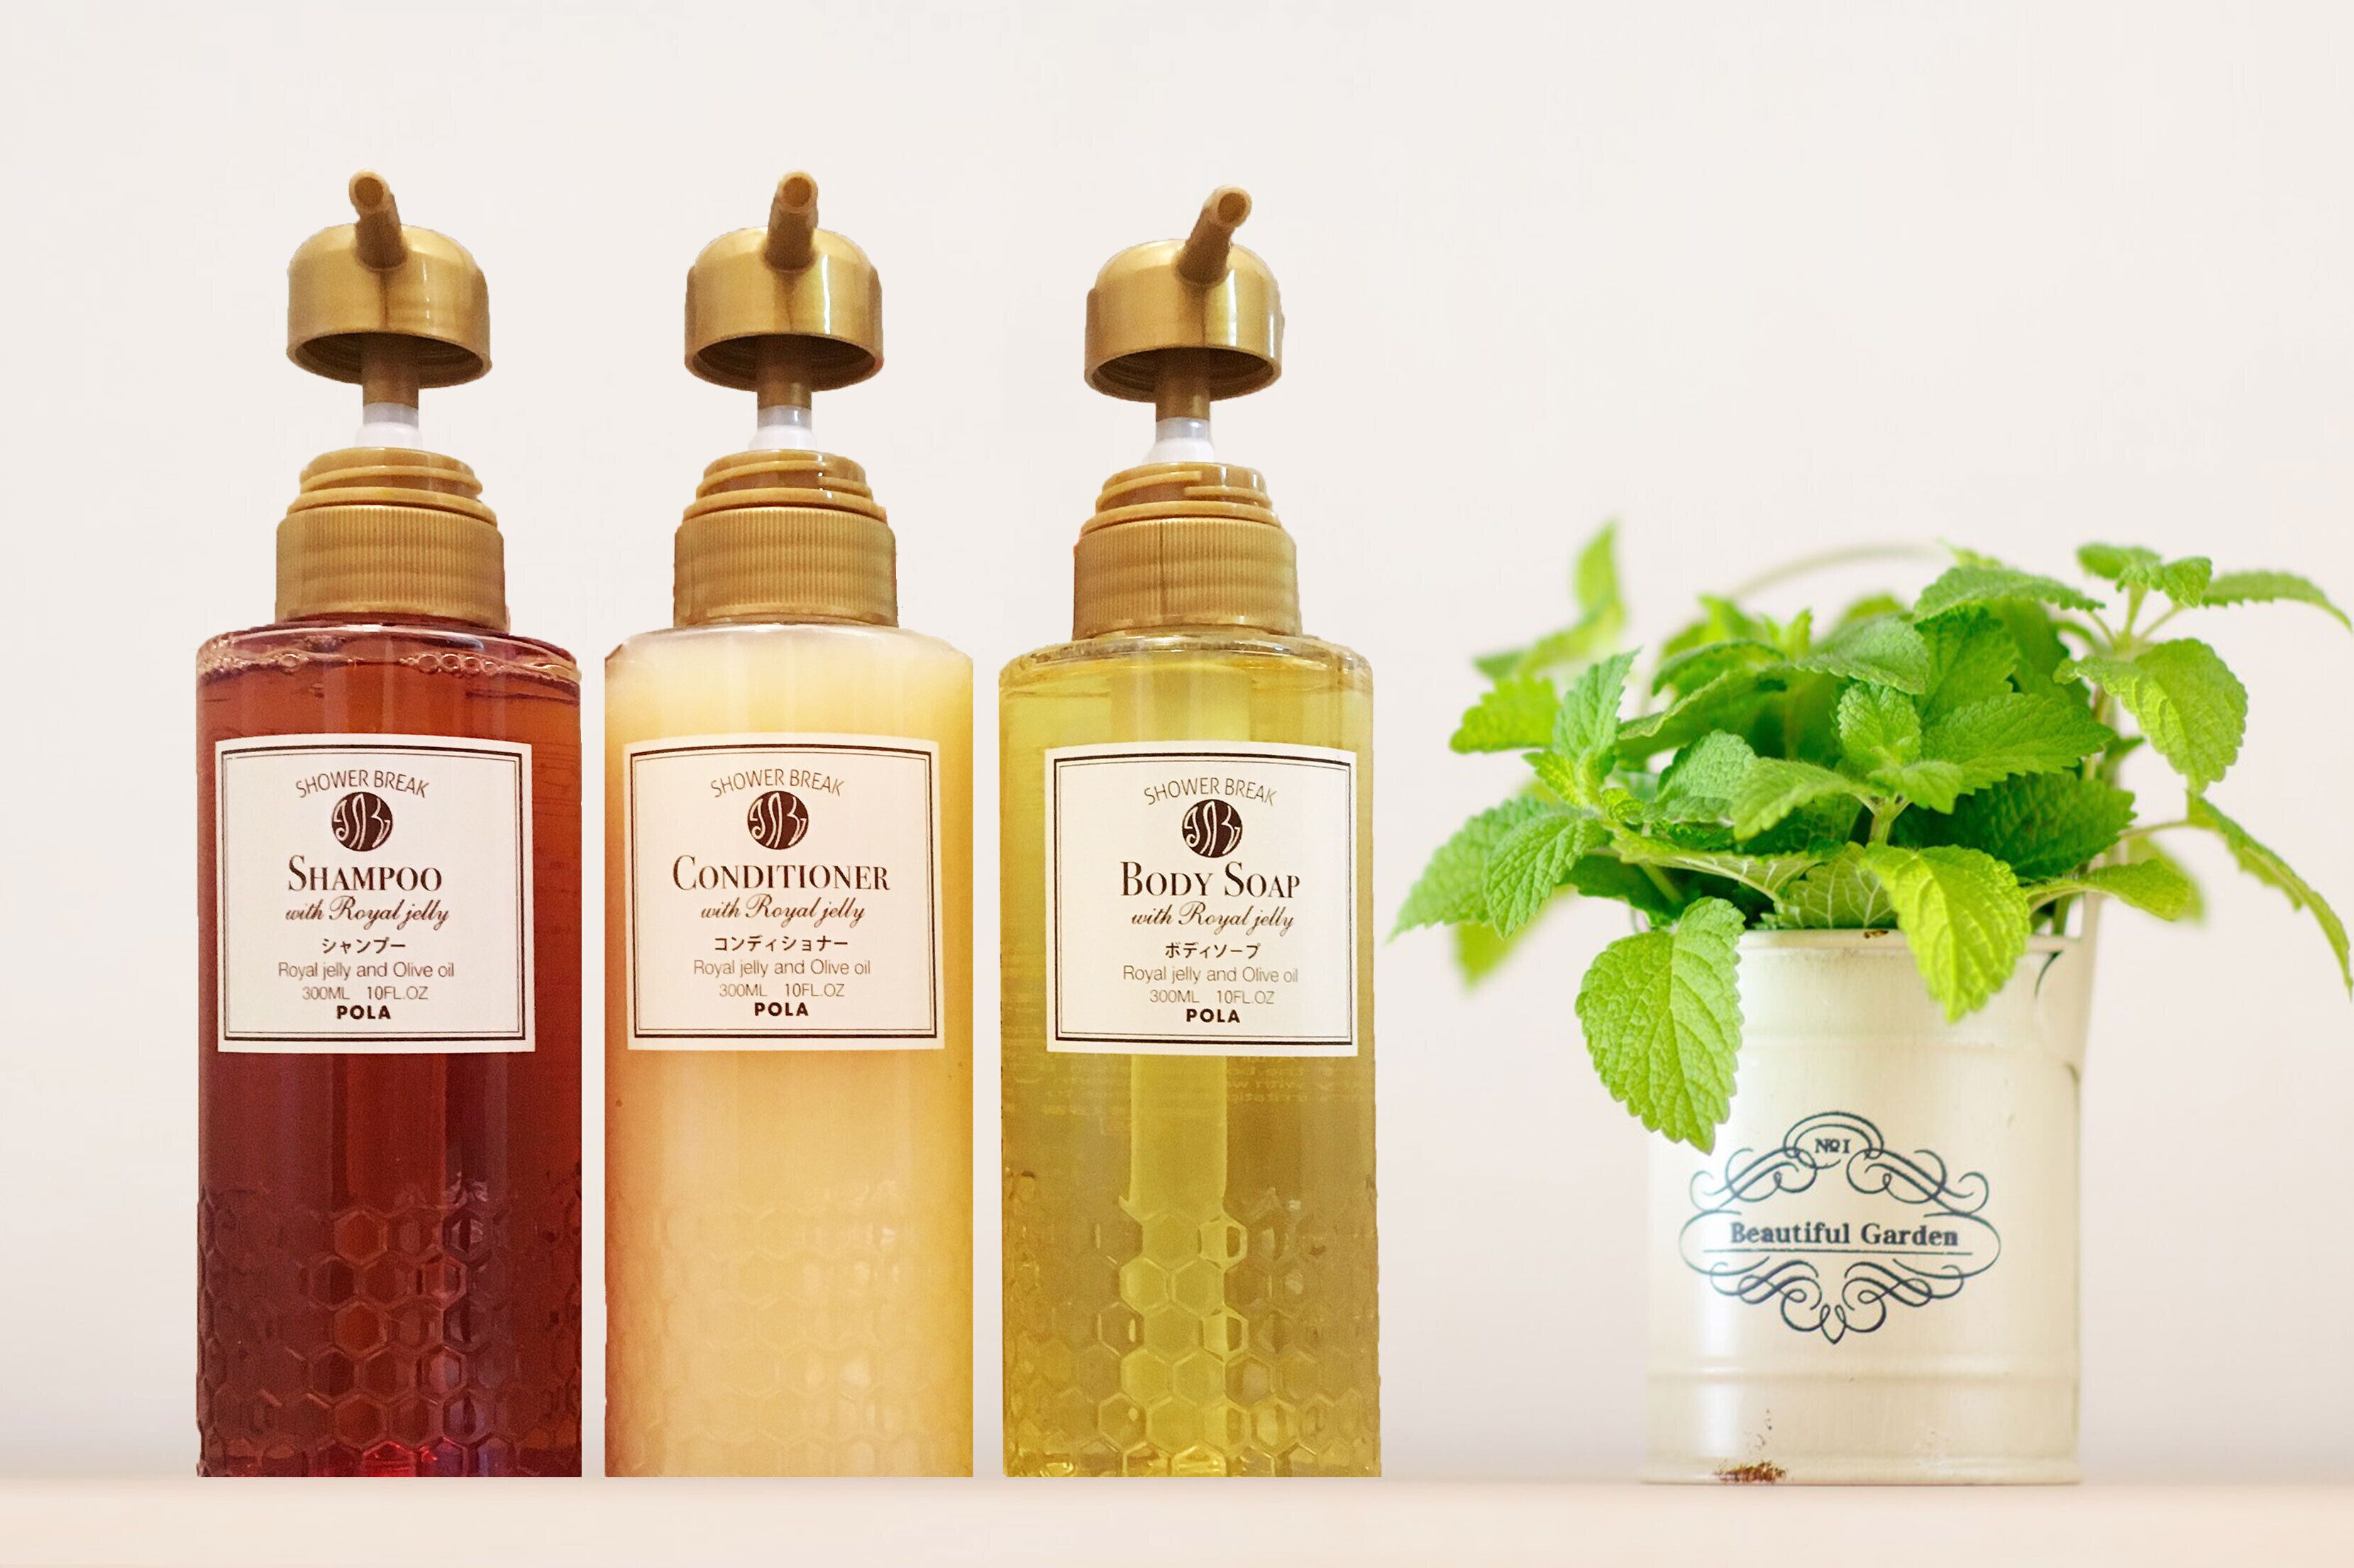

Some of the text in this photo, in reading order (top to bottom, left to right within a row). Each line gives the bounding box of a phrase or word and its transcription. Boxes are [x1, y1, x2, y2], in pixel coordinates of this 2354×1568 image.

[296, 770, 429, 798] SHOWER BREAK
[710, 769, 845, 797] SHOWER BREAK
[1144, 778, 1276, 805] SHOWER BREAK
[286, 895, 450, 931] with Royal jelly
[701, 894, 865, 928] with Royal jelly
[1132, 902, 1295, 937] with Royal jelly
[321, 936, 406, 954] シャンプー
[714, 935, 849, 953] コンディショナー
[1165, 942, 1261, 959] ボディソープ
[278, 962, 454, 980] Royal jelly and Olive oil
[694, 959, 871, 977] Royal jelly and Olive oil
[1124, 965, 1298, 985] Royal jelly and Olive oil
[302, 986, 350, 1000] 300ML
[719, 983, 768, 998] 300ML
[1150, 990, 1200, 1003] 300ML
[337, 1005, 391, 1020] POLA
[755, 1003, 809, 1016] POLA
[1186, 1008, 1240, 1023] POLA
[1730, 1220, 1958, 1246] Beautiful Garden
